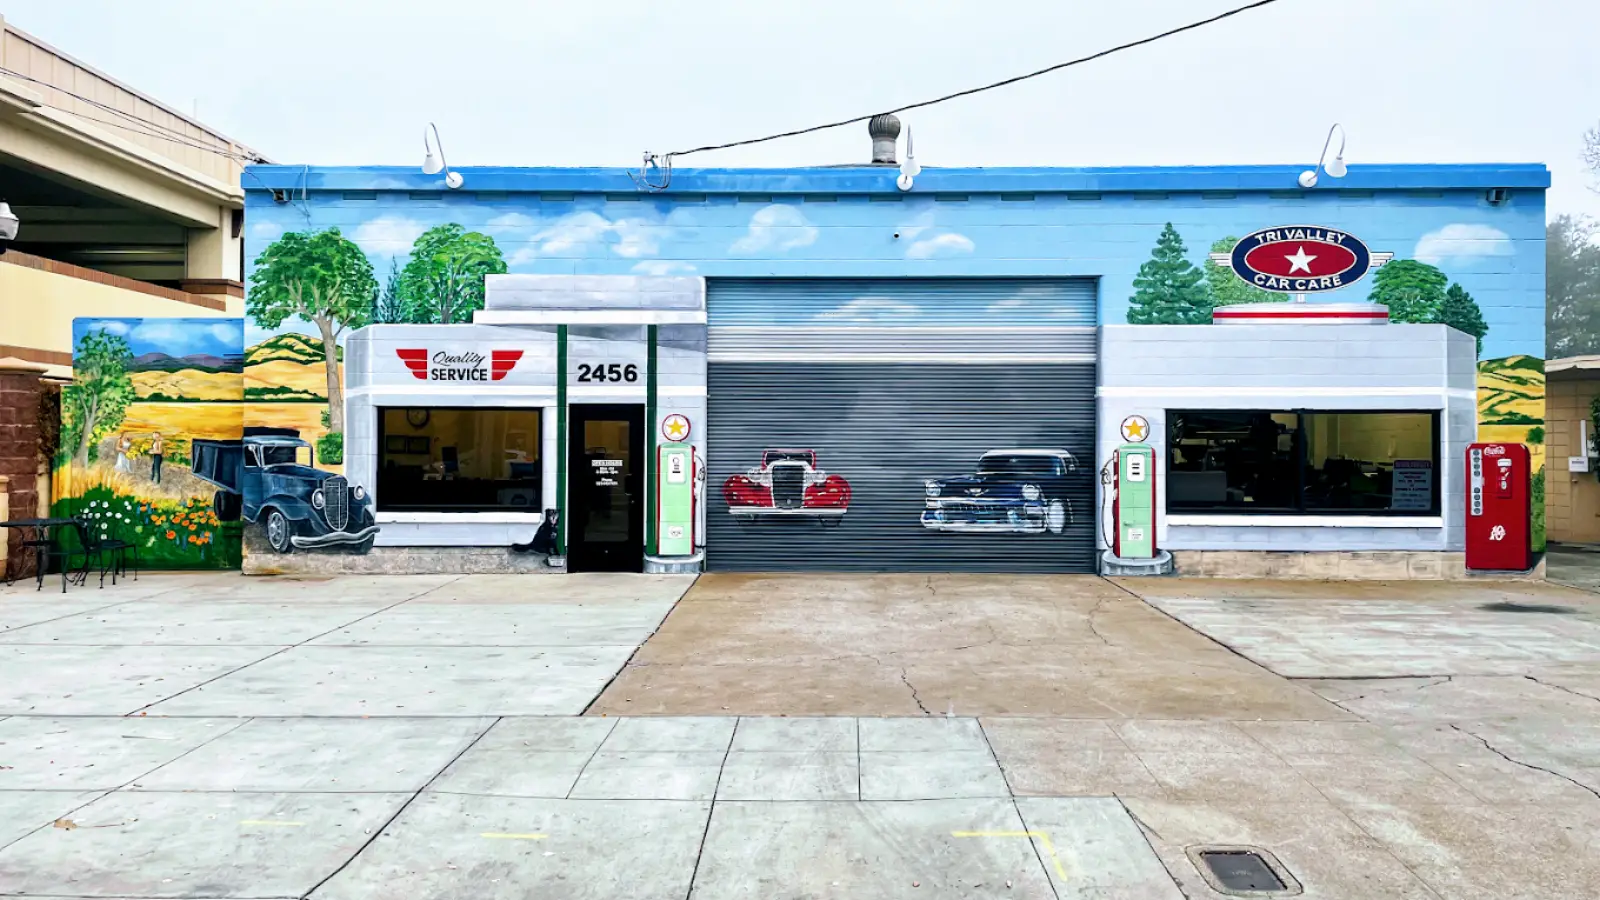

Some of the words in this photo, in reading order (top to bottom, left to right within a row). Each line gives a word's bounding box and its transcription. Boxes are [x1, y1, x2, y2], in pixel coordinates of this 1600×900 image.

[1254, 230, 1281, 244] TRI
[1285, 229, 1346, 244] VALLEY
[1254, 274, 1290, 290] CAR
[1295, 275, 1342, 290] CARE
[432, 351, 486, 367] Quality
[431, 368, 488, 381] SERVICE
[577, 364, 638, 382] 2456
